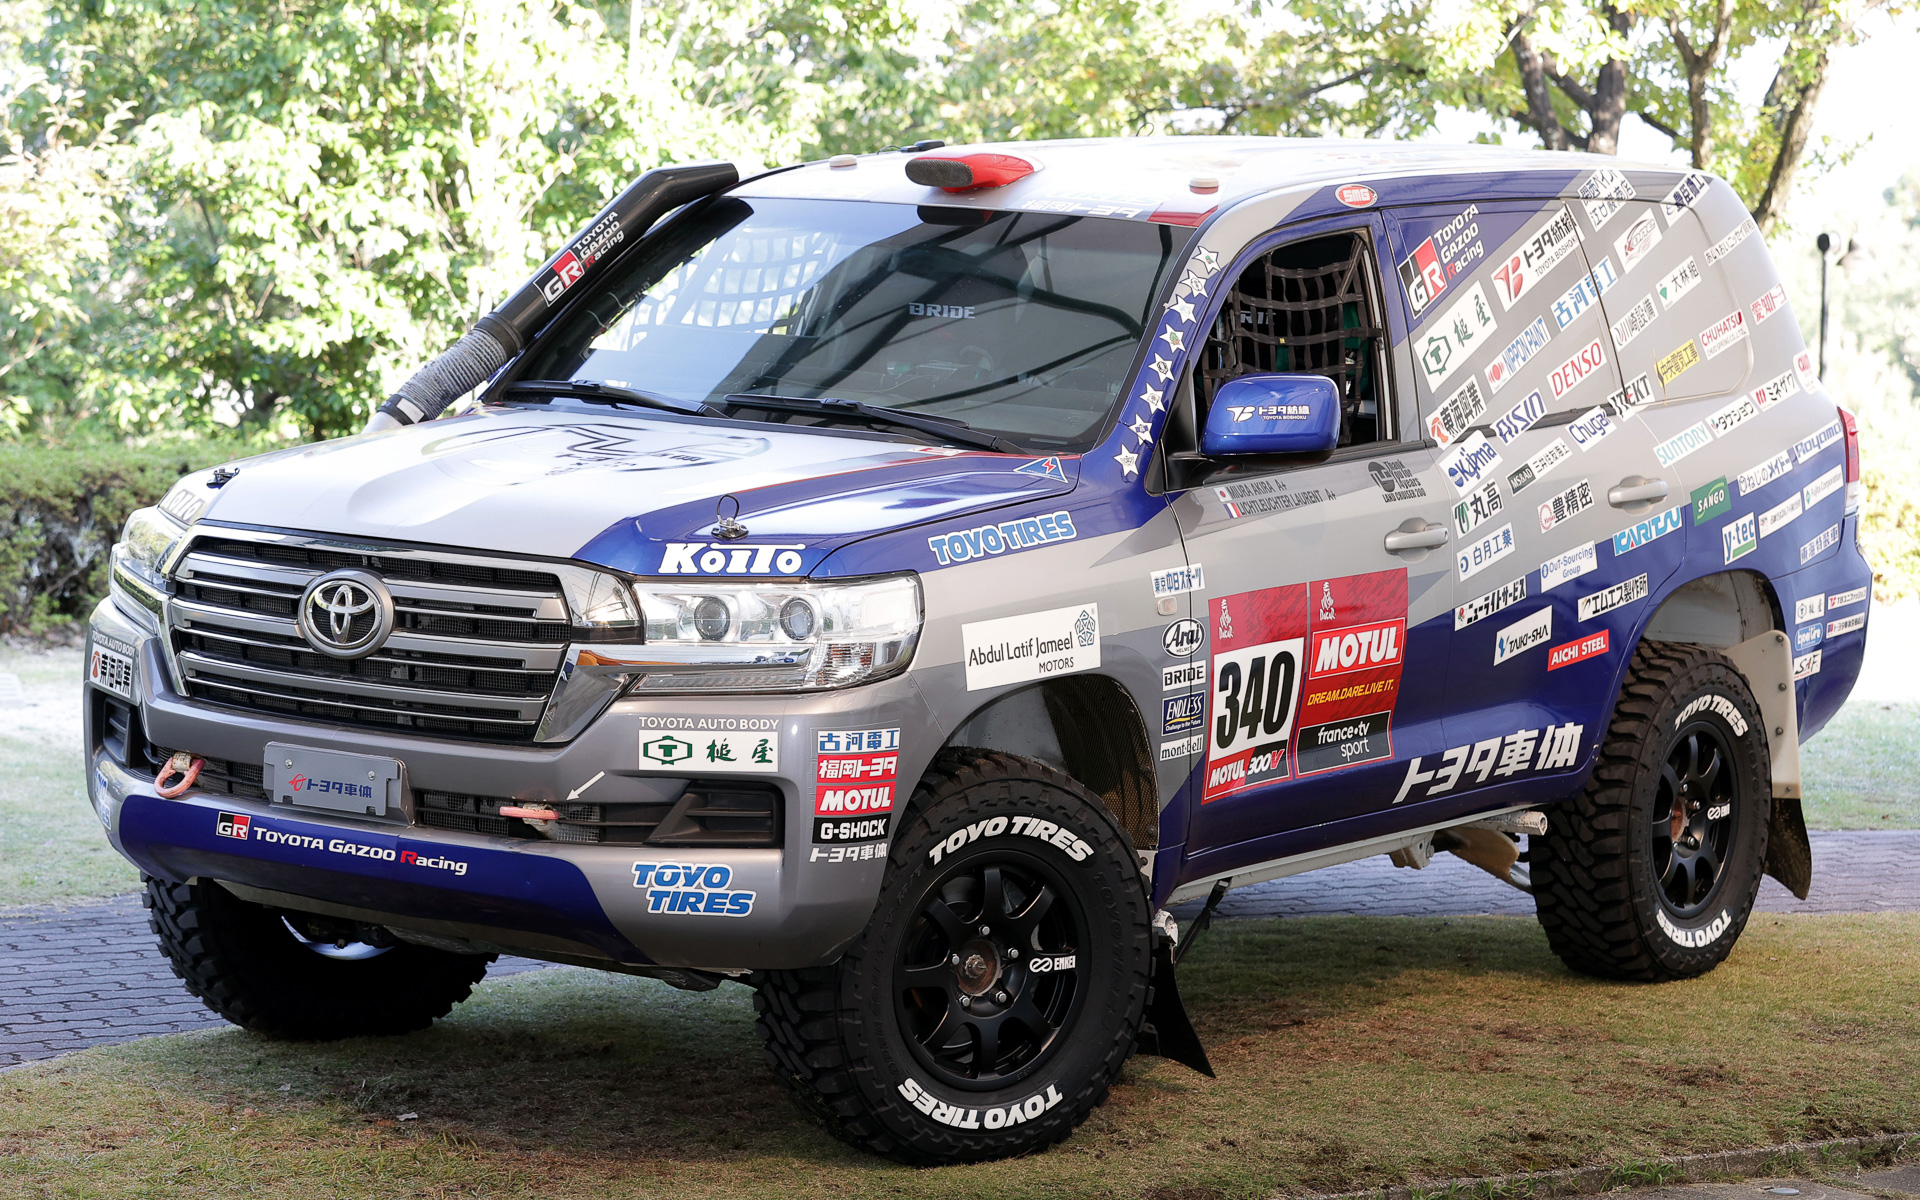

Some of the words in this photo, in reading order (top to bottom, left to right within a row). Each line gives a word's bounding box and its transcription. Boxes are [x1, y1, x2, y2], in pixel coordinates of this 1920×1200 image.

[572, 211, 618, 251] TOYOTA
[580, 221, 621, 260] GAZOO
[1433, 203, 1480, 247] TOYOTA
[1441, 223, 1479, 264] GAZOO
[584, 230, 625, 268] Racing
[1445, 240, 1485, 281] Racing
[543, 260, 582, 302] GR
[1408, 260, 1447, 312] GR
[1671, 260, 1699, 293] 大林組
[908, 302, 976, 319] BRIDE
[1553, 263, 1617, 329] 古河電工
[1501, 333, 1532, 376] NIPPON
[1524, 317, 1549, 354] PAINT
[1701, 311, 1742, 346] CHUHATSU
[1551, 342, 1602, 397] DENSO
[1497, 392, 1545, 444] AISIN
[1568, 410, 1612, 446] Chugai
[1718, 400, 1754, 430] タケショウ
[1655, 426, 1709, 465] SUNTORY
[1383, 459, 1406, 472] Thank
[1510, 467, 1534, 490] MS&AD
[1228, 483, 1252, 500] MIURA
[1253, 481, 1272, 497] AKIRA
[1291, 489, 1322, 508] LAURENT
[1381, 491, 1396, 503] LAND
[1395, 489, 1416, 502] CRUISER
[1469, 480, 1503, 526] 丸高
[1552, 482, 1593, 524] 豊精密
[1696, 489, 1725, 514] SANGO
[930, 527, 1003, 564] TOYO
[1000, 511, 1076, 547] TIRES
[1473, 528, 1512, 566] 白月工業
[1725, 517, 1755, 560] y-tec
[1562, 565, 1581, 578] Group
[1467, 578, 1526, 624] ニューライトサービス
[1592, 574, 1648, 616] エムエス製作所
[968, 643, 1005, 667] Abdul
[1006, 638, 1034, 661] Latif
[1035, 632, 1074, 658] Jameel
[1163, 622, 1202, 650] Arai
[1314, 626, 1401, 673] MOTUL
[1550, 649, 1579, 666] AICHI
[1581, 636, 1606, 656] STEEL
[1038, 657, 1074, 674] MOTORS
[1163, 664, 1204, 687] BRIDE
[1165, 695, 1203, 720] ENDLESS
[1216, 650, 1296, 749] 340
[1674, 694, 1712, 732] TOYO
[1709, 695, 1750, 738] TIRES
[638, 716, 695, 729] TOYOTA
[697, 718, 738, 730] AUTO
[738, 718, 780, 731] BODY
[819, 729, 900, 751] 古河電工
[818, 755, 898, 779] 福岡トヨタ
[1208, 757, 1247, 790] MOTUL
[1246, 748, 1286, 777] 300V
[1339, 738, 1371, 762] sport
[1392, 721, 1585, 804] トヨタ車体
[307, 777, 374, 800] トヨタ車体
[819, 785, 892, 812] MOTUL
[819, 817, 886, 840] G-SHOCK
[928, 816, 1010, 866] TOYO
[1010, 815, 1096, 863] TIRES
[218, 821, 248, 840] GR
[253, 825, 325, 851] TOYOTA
[328, 837, 397, 862] GAZOO
[399, 849, 469, 876] Racing
[808, 842, 888, 863] トヨタ車体
[633, 863, 732, 890] TOYO
[647, 890, 755, 915] TIRES
[1656, 907, 1696, 949] TIRES
[1693, 908, 1733, 949] TOYO
[897, 1077, 981, 1130] TIRES
[983, 1083, 1064, 1130] TOYO
